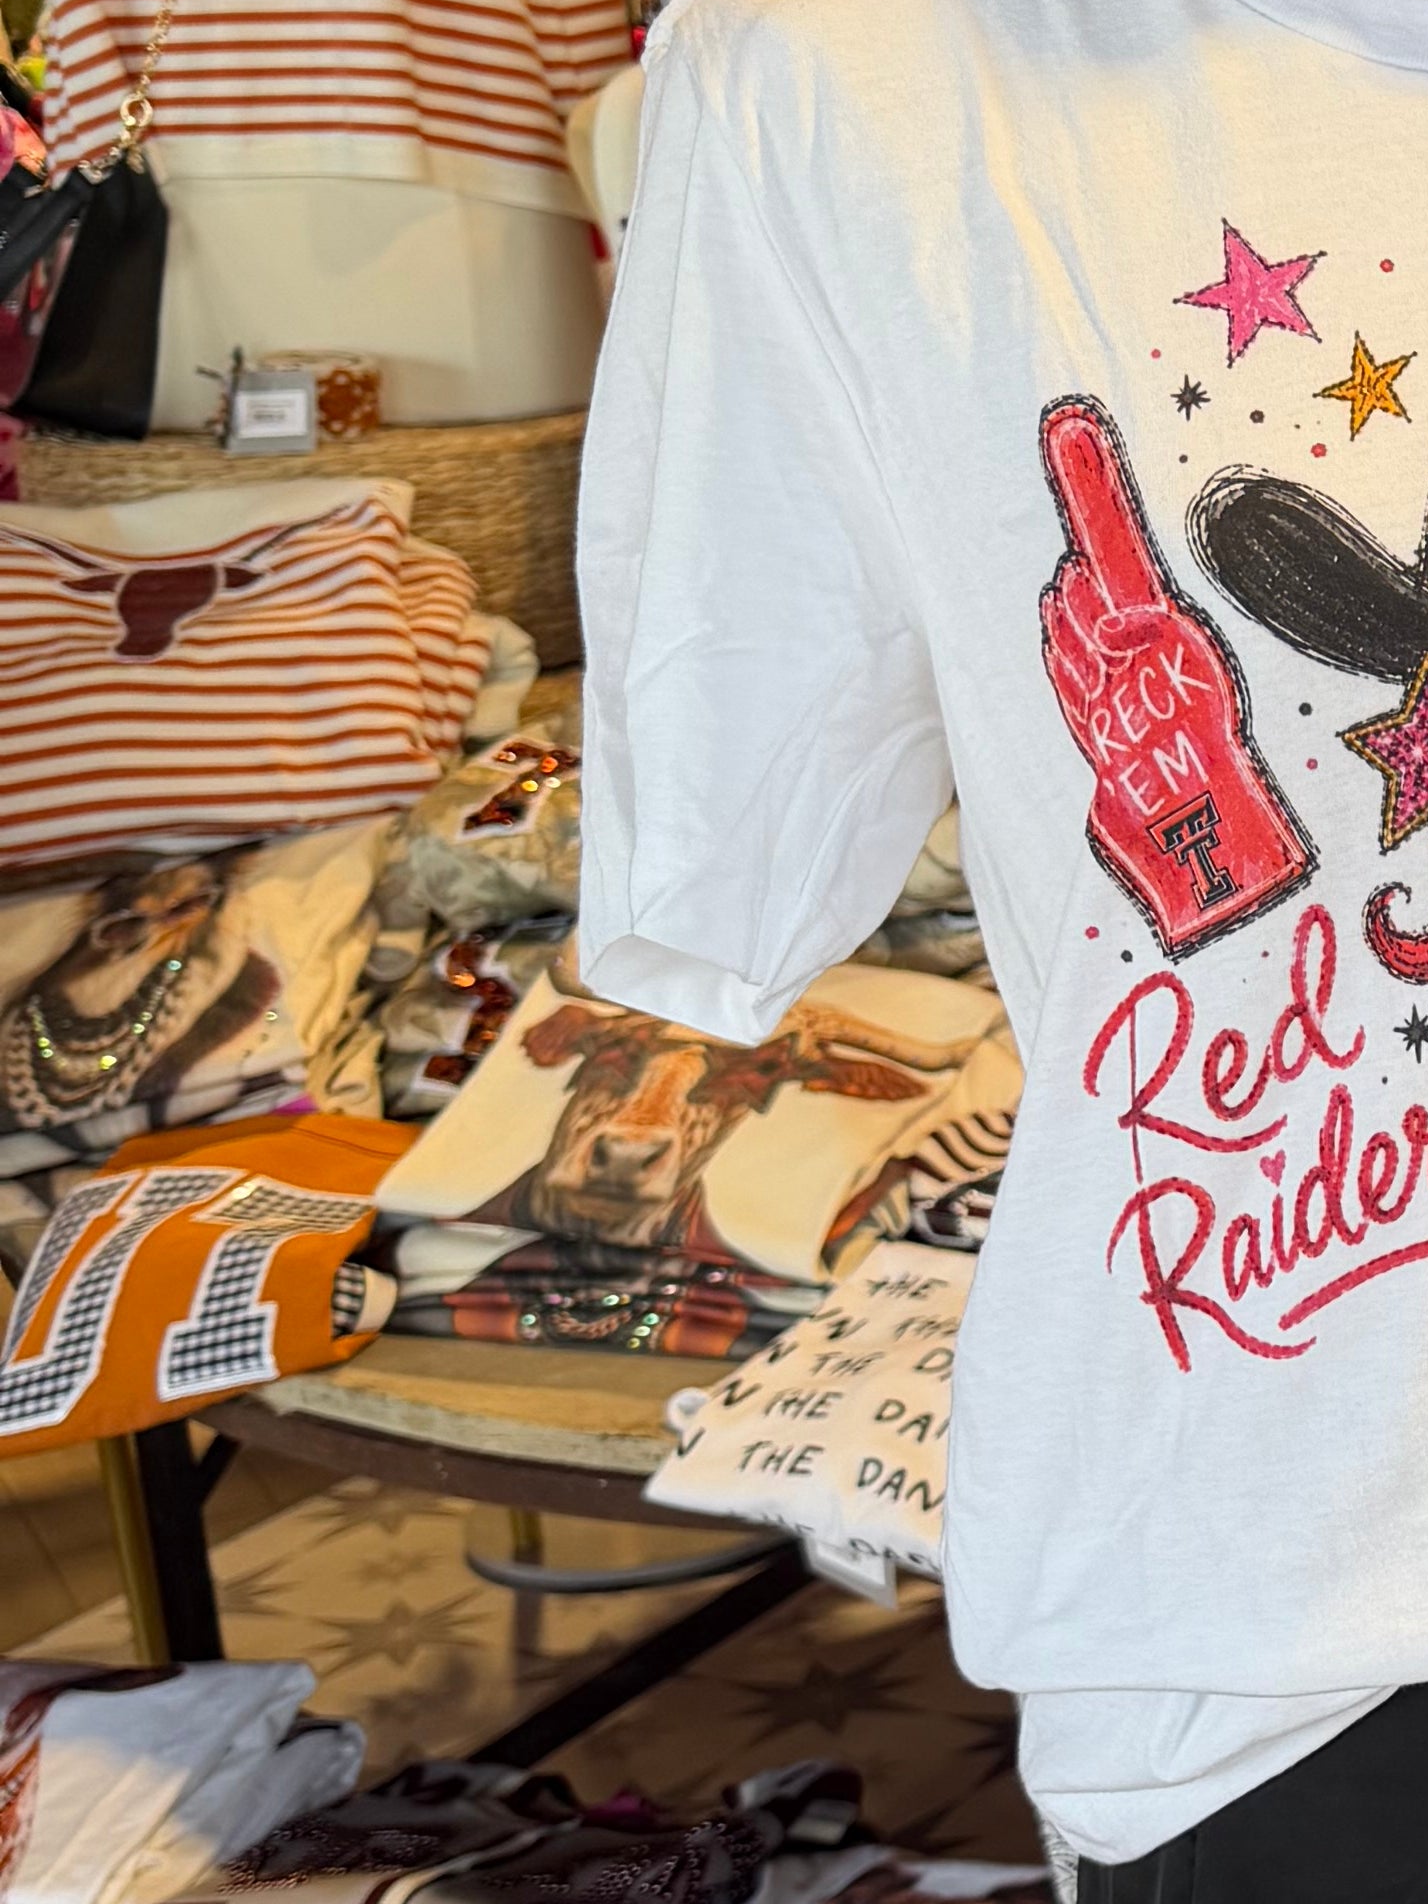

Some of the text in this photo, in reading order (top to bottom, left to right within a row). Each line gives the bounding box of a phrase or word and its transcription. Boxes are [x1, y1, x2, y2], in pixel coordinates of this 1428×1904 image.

[1090, 642, 1214, 766] RECK
[1102, 730, 1209, 817] 'EM
[1083, 904, 1365, 1184] Red
[765, 1390, 843, 1419] THE
[738, 1440, 825, 1475] THE
